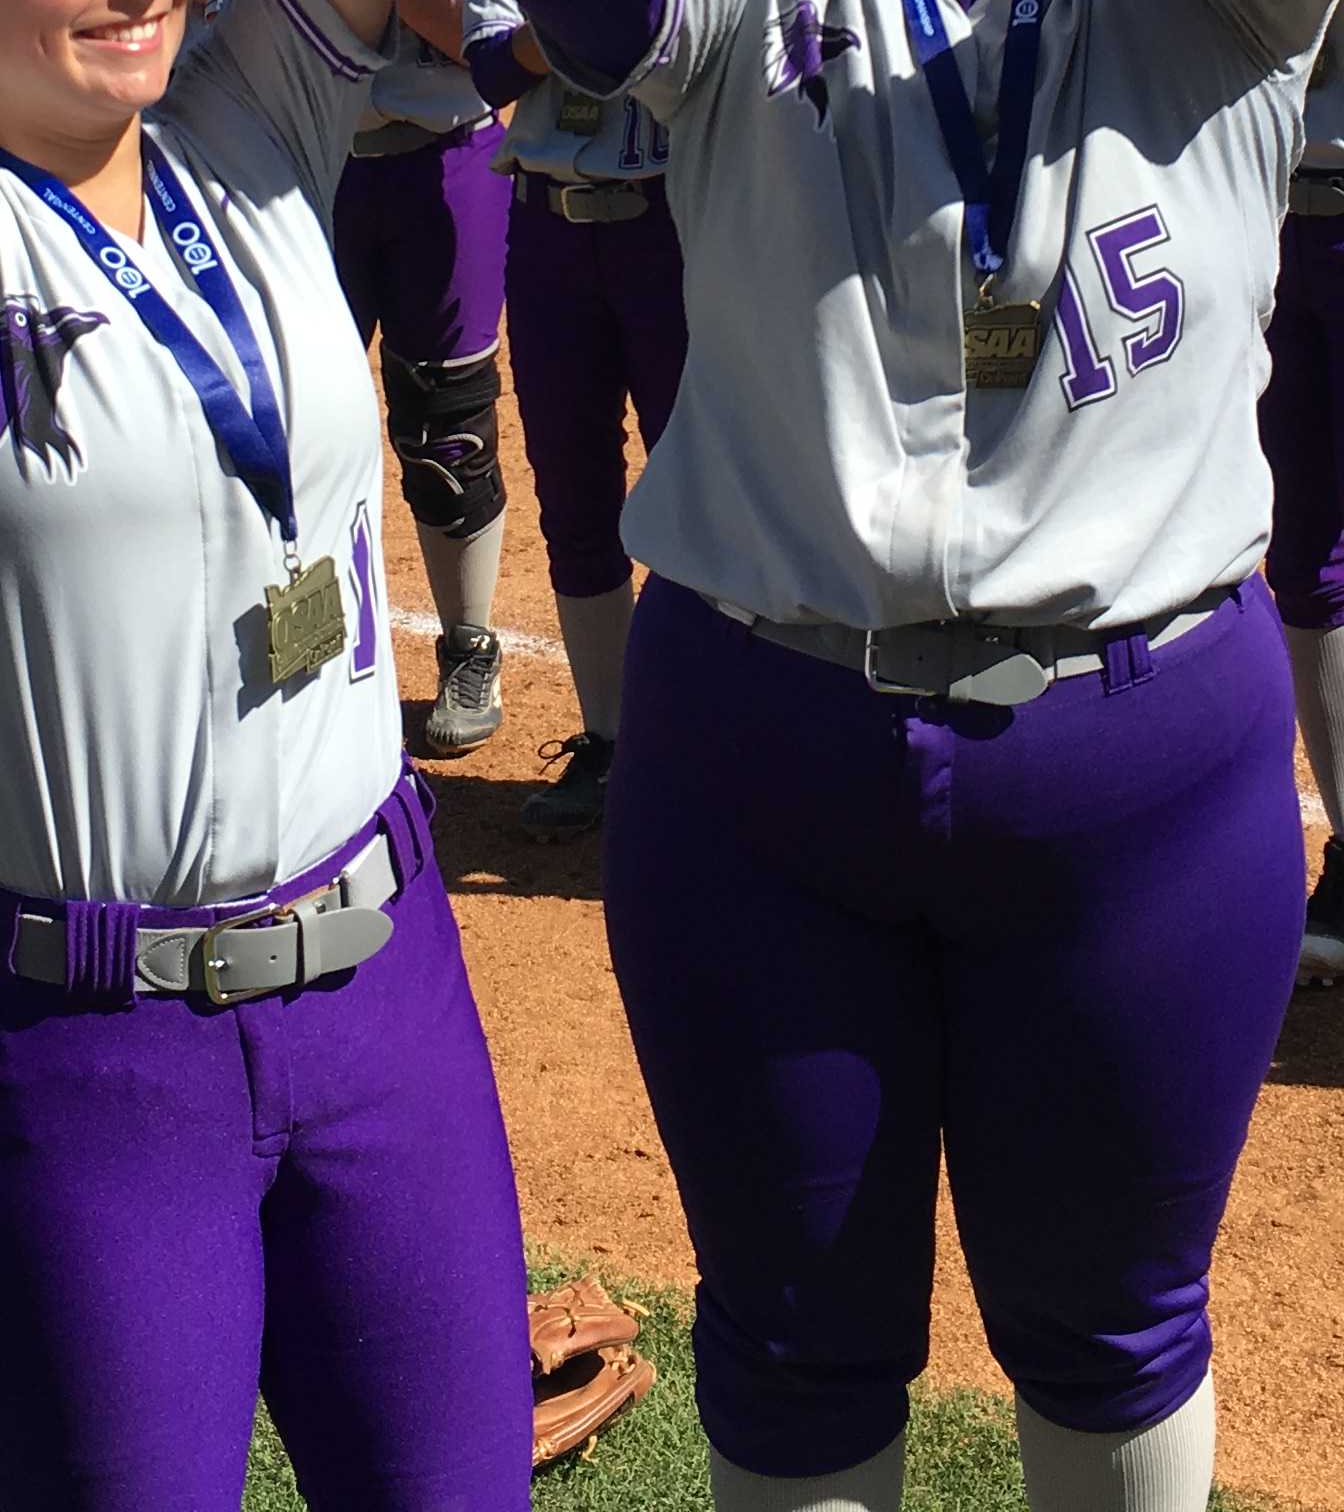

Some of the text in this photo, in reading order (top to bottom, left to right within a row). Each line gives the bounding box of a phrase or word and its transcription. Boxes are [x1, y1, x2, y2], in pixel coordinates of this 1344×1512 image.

[99, 246, 152, 299] 100
[172, 221, 218, 275] 100
[1053, 202, 1186, 412] 15
[962, 325, 1038, 360] SAA
